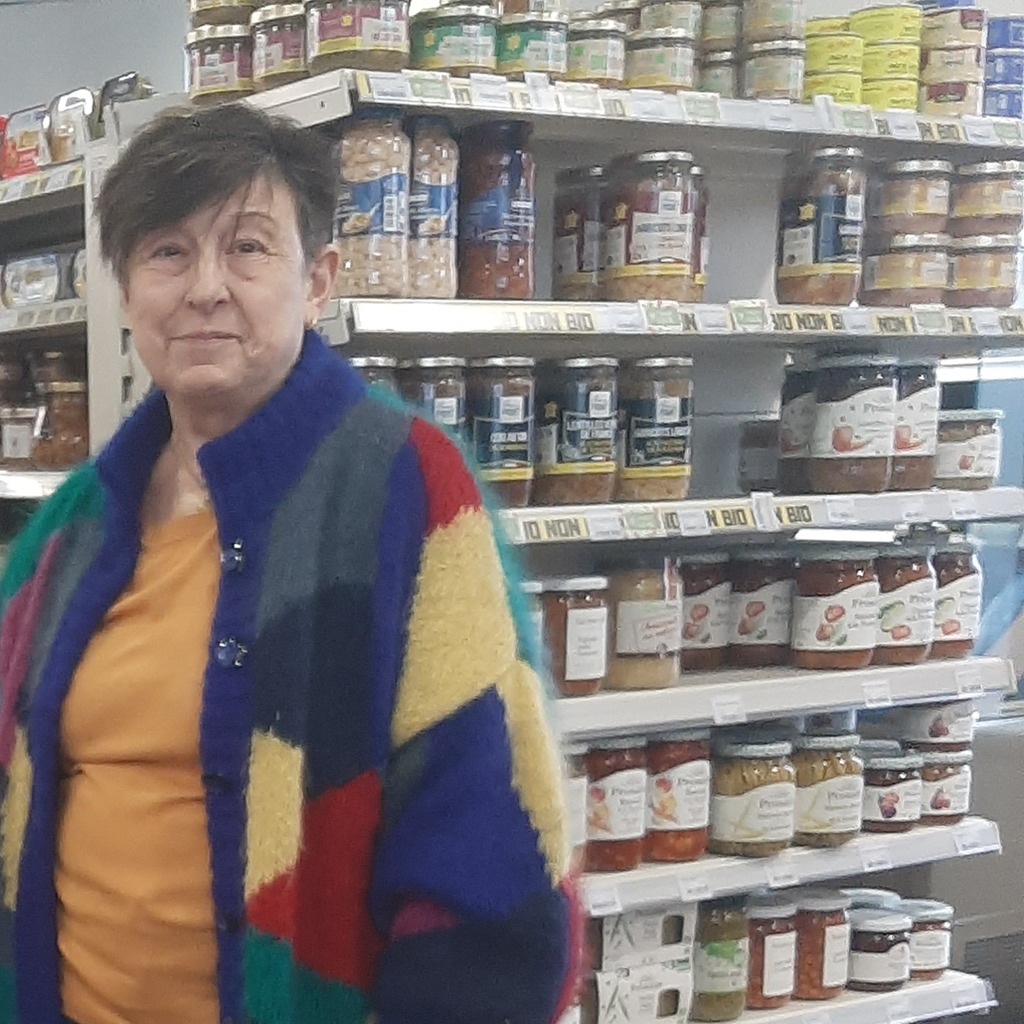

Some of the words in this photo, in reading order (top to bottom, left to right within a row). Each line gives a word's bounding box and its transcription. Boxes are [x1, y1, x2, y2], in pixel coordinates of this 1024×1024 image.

[722, 508, 748, 527] BIO
[787, 505, 813, 524] BIO
[546, 517, 582, 539] NON
